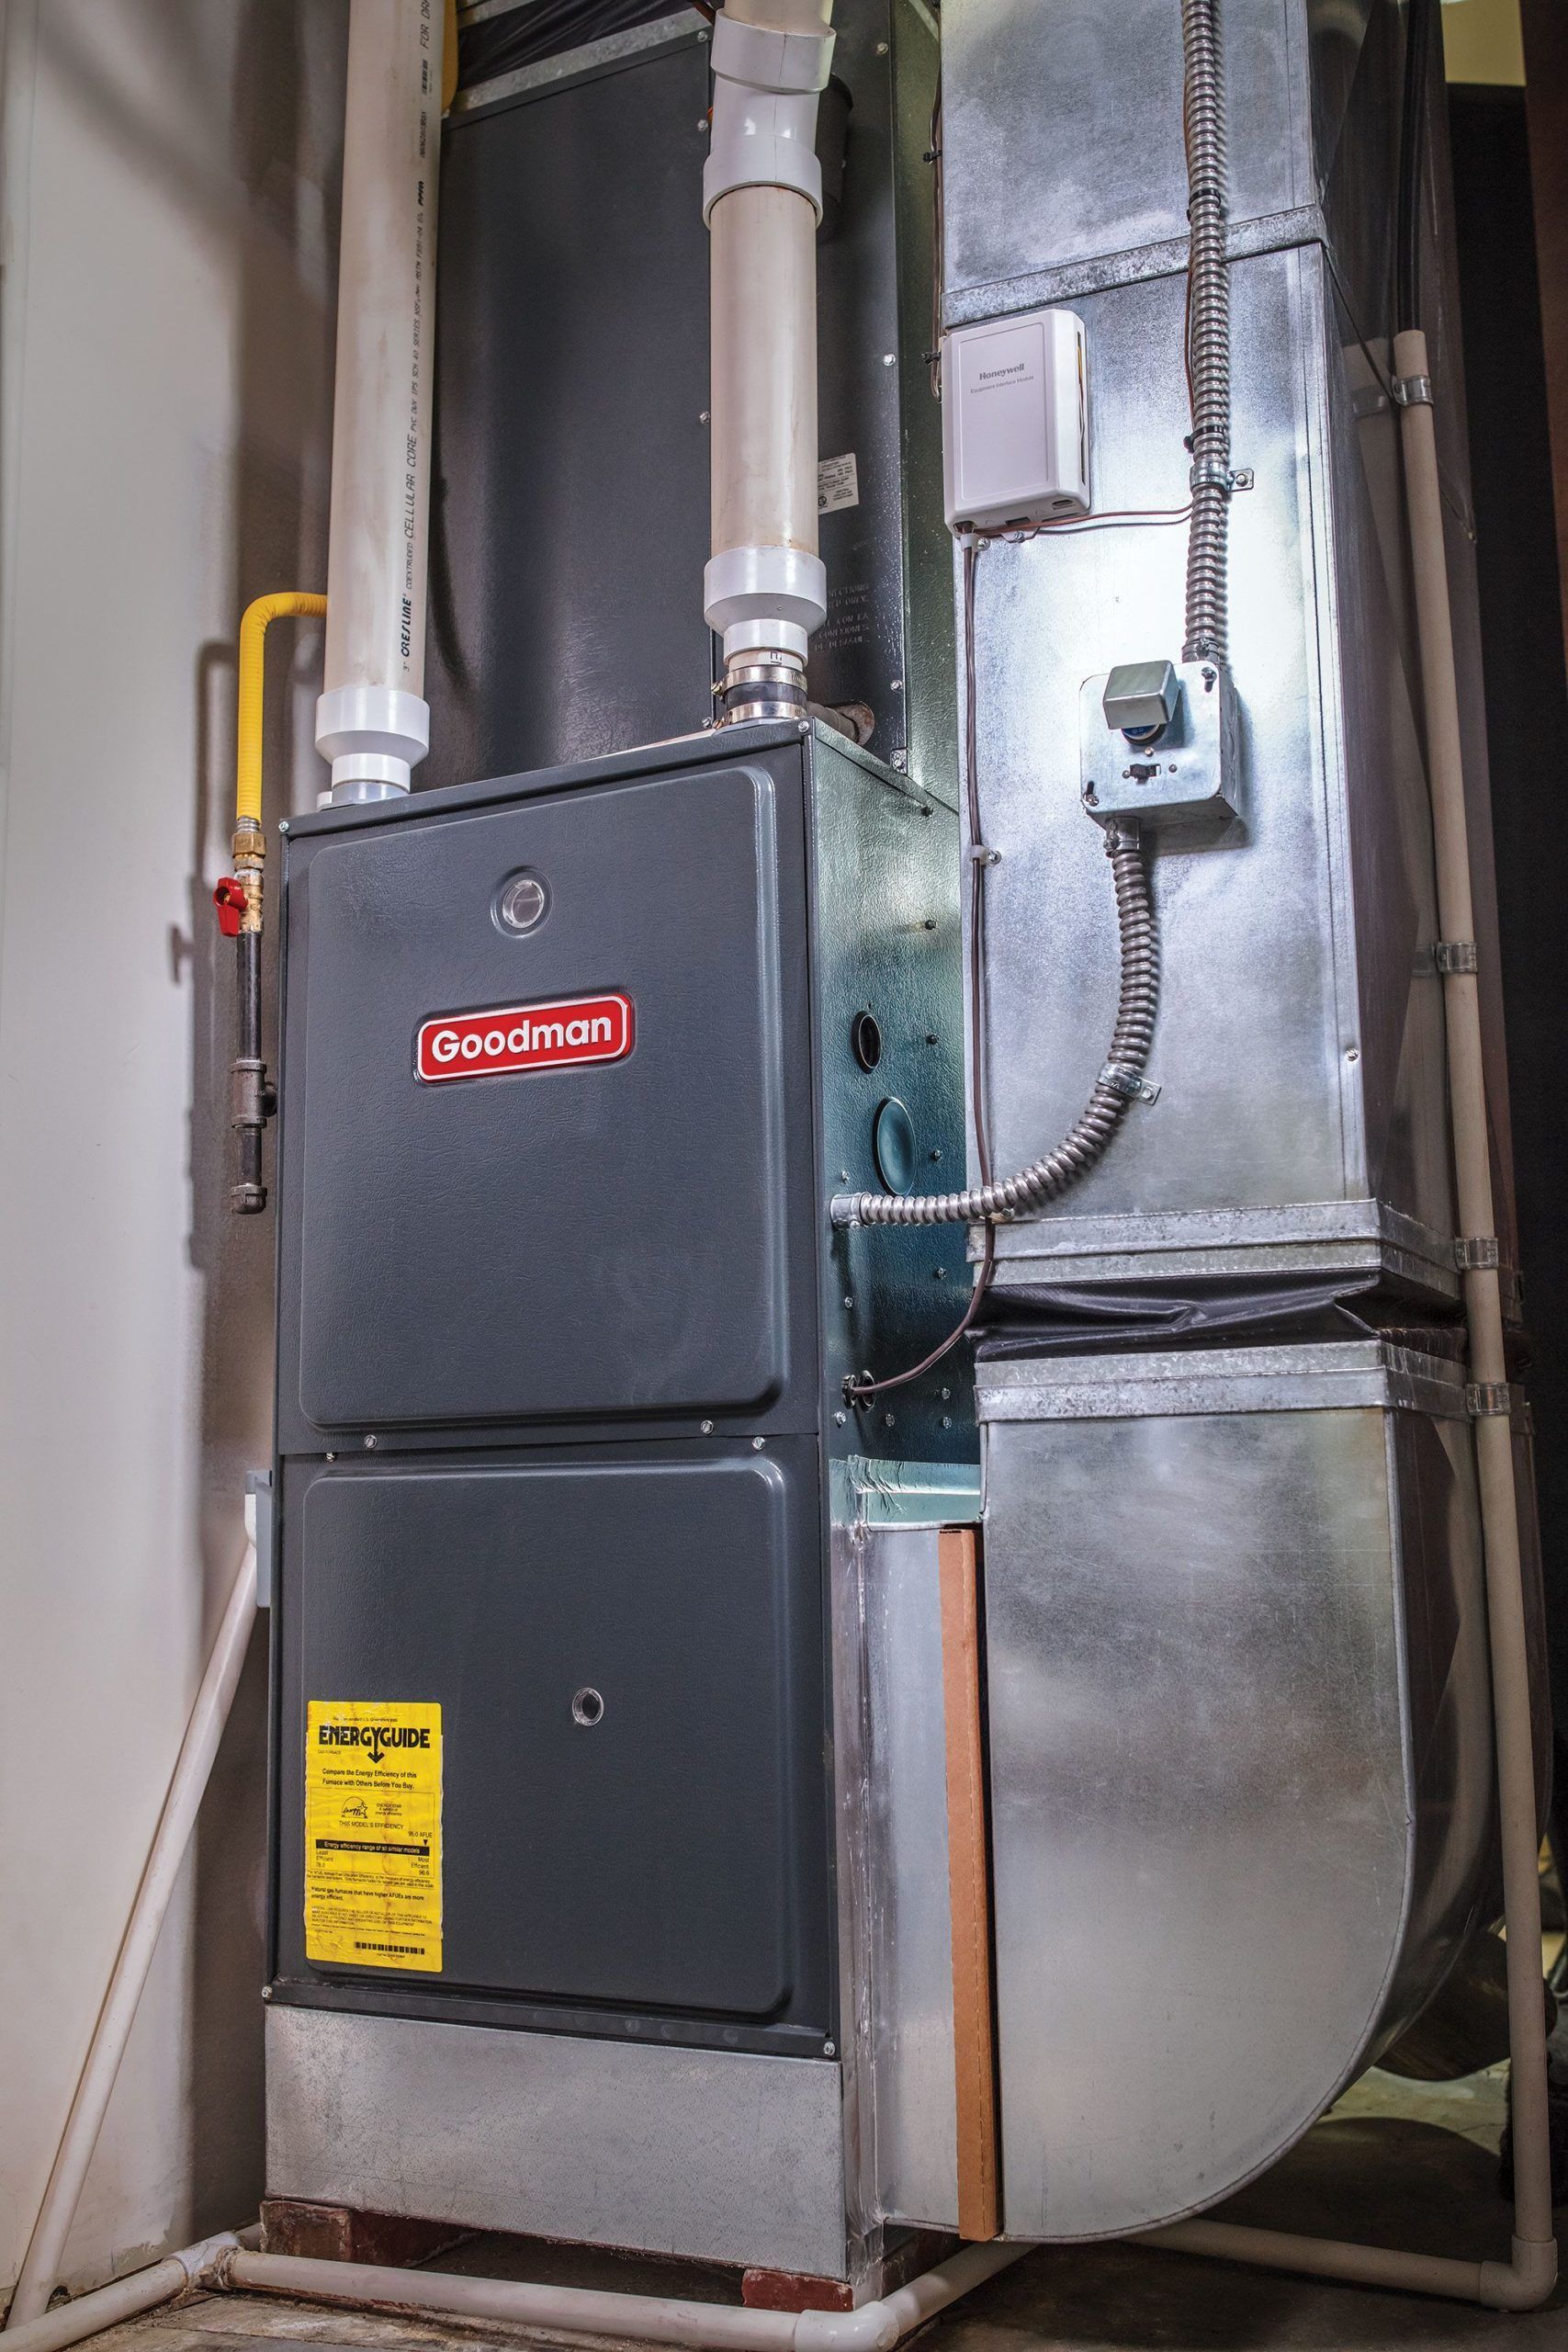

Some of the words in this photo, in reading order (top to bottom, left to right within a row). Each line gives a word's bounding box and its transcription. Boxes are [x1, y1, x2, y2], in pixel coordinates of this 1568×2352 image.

[420, 24, 430, 50] FOR
[412, 318, 421, 347] SERIES
[979, 363, 1024, 380] Honeywell
[406, 434, 417, 468] CORE
[404, 473, 415, 538] CELLULAR
[432, 1016, 612, 1062] Goodman
[319, 1724, 430, 1748] ENERGYGUIDE
[355, 1770, 373, 1778] Energy
[375, 1770, 399, 1779] Efficiency
[340, 1842, 361, 1850] efficiency
